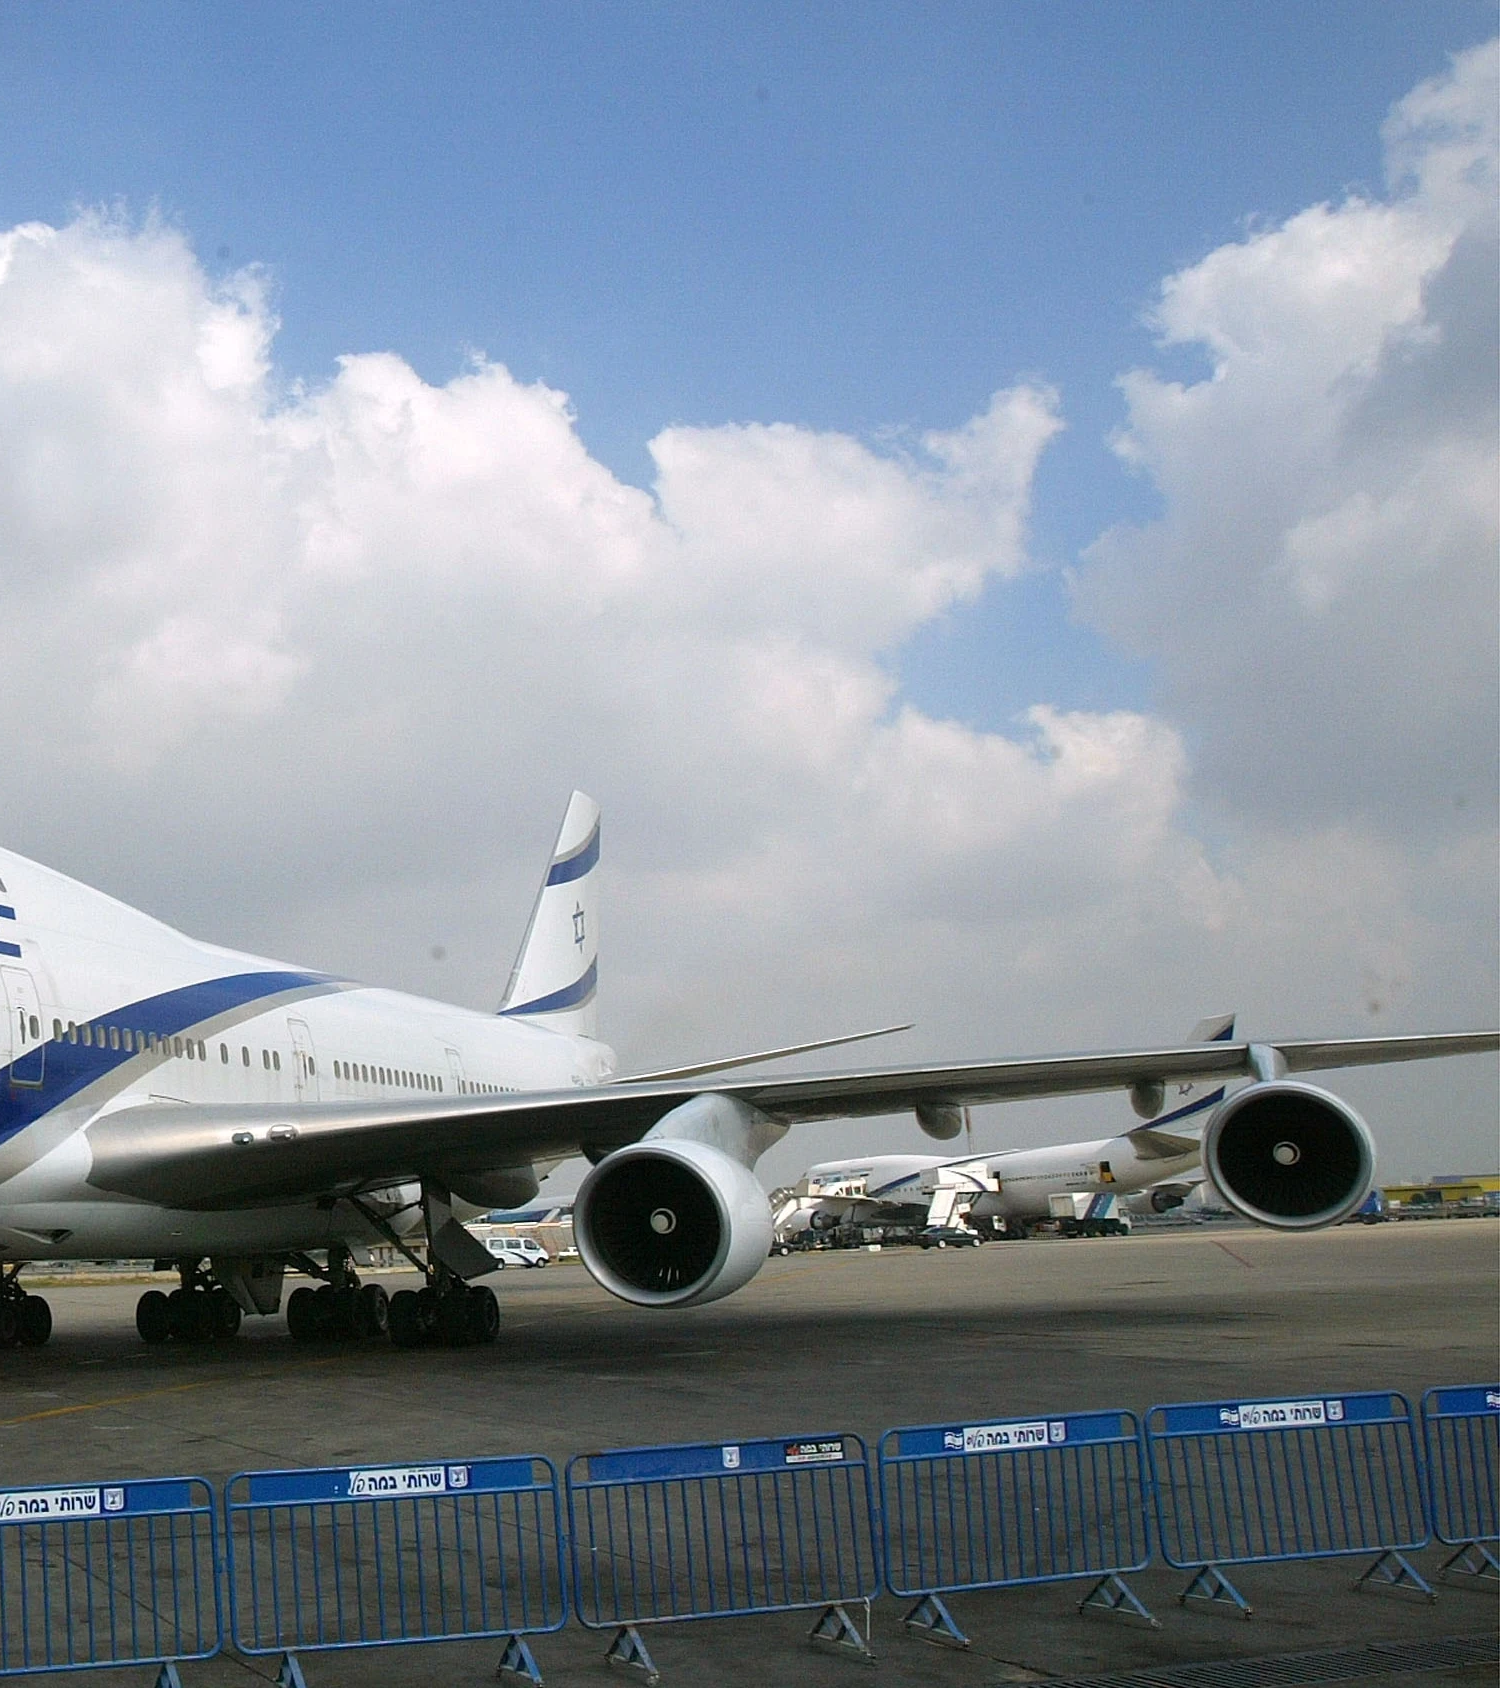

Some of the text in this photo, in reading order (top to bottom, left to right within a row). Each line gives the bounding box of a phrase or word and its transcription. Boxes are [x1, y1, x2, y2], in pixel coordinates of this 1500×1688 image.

[367, 1475, 397, 1491] במה
[403, 1472, 442, 1488] שרותי
[18, 1498, 49, 1515] במה
[55, 1494, 96, 1512] שרותי
